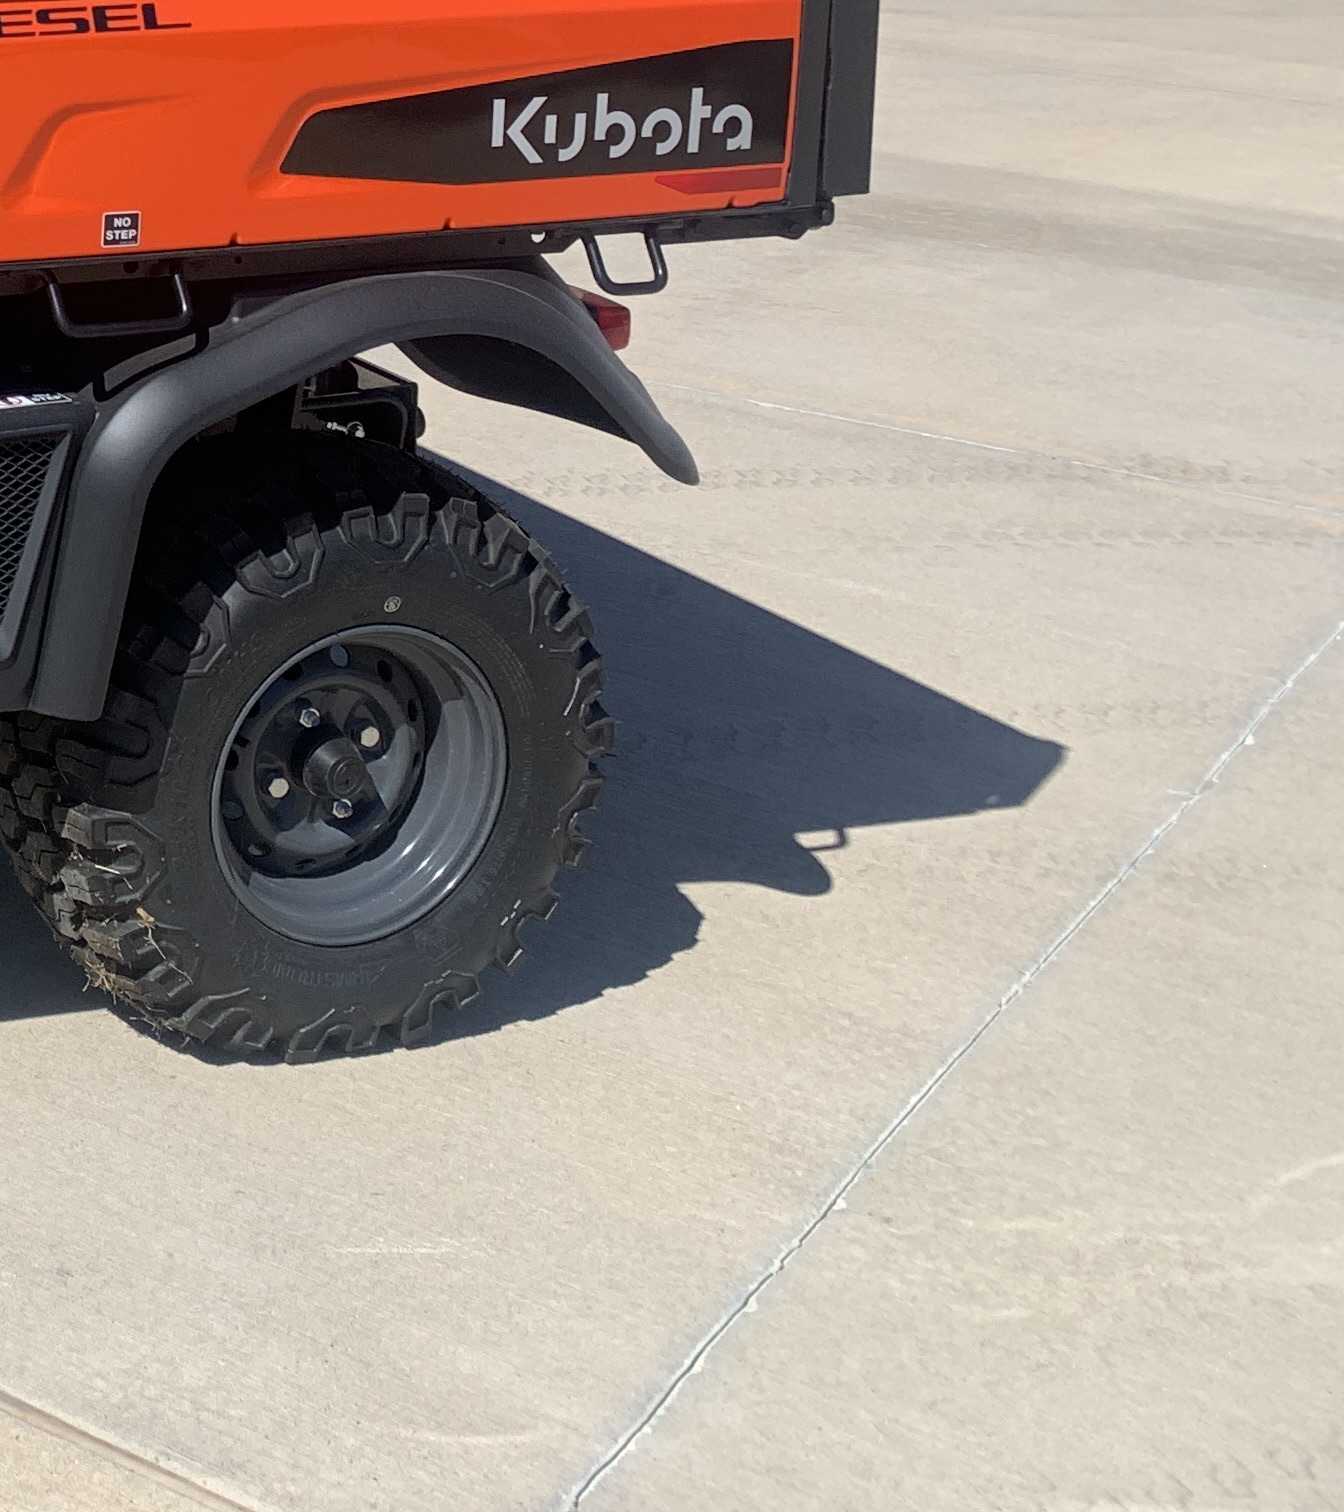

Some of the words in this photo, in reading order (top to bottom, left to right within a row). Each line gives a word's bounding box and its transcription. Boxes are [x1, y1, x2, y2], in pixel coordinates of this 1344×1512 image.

[491, 87, 753, 164] Kubota
[113, 216, 132, 228] NO
[105, 229, 137, 240] STEP
